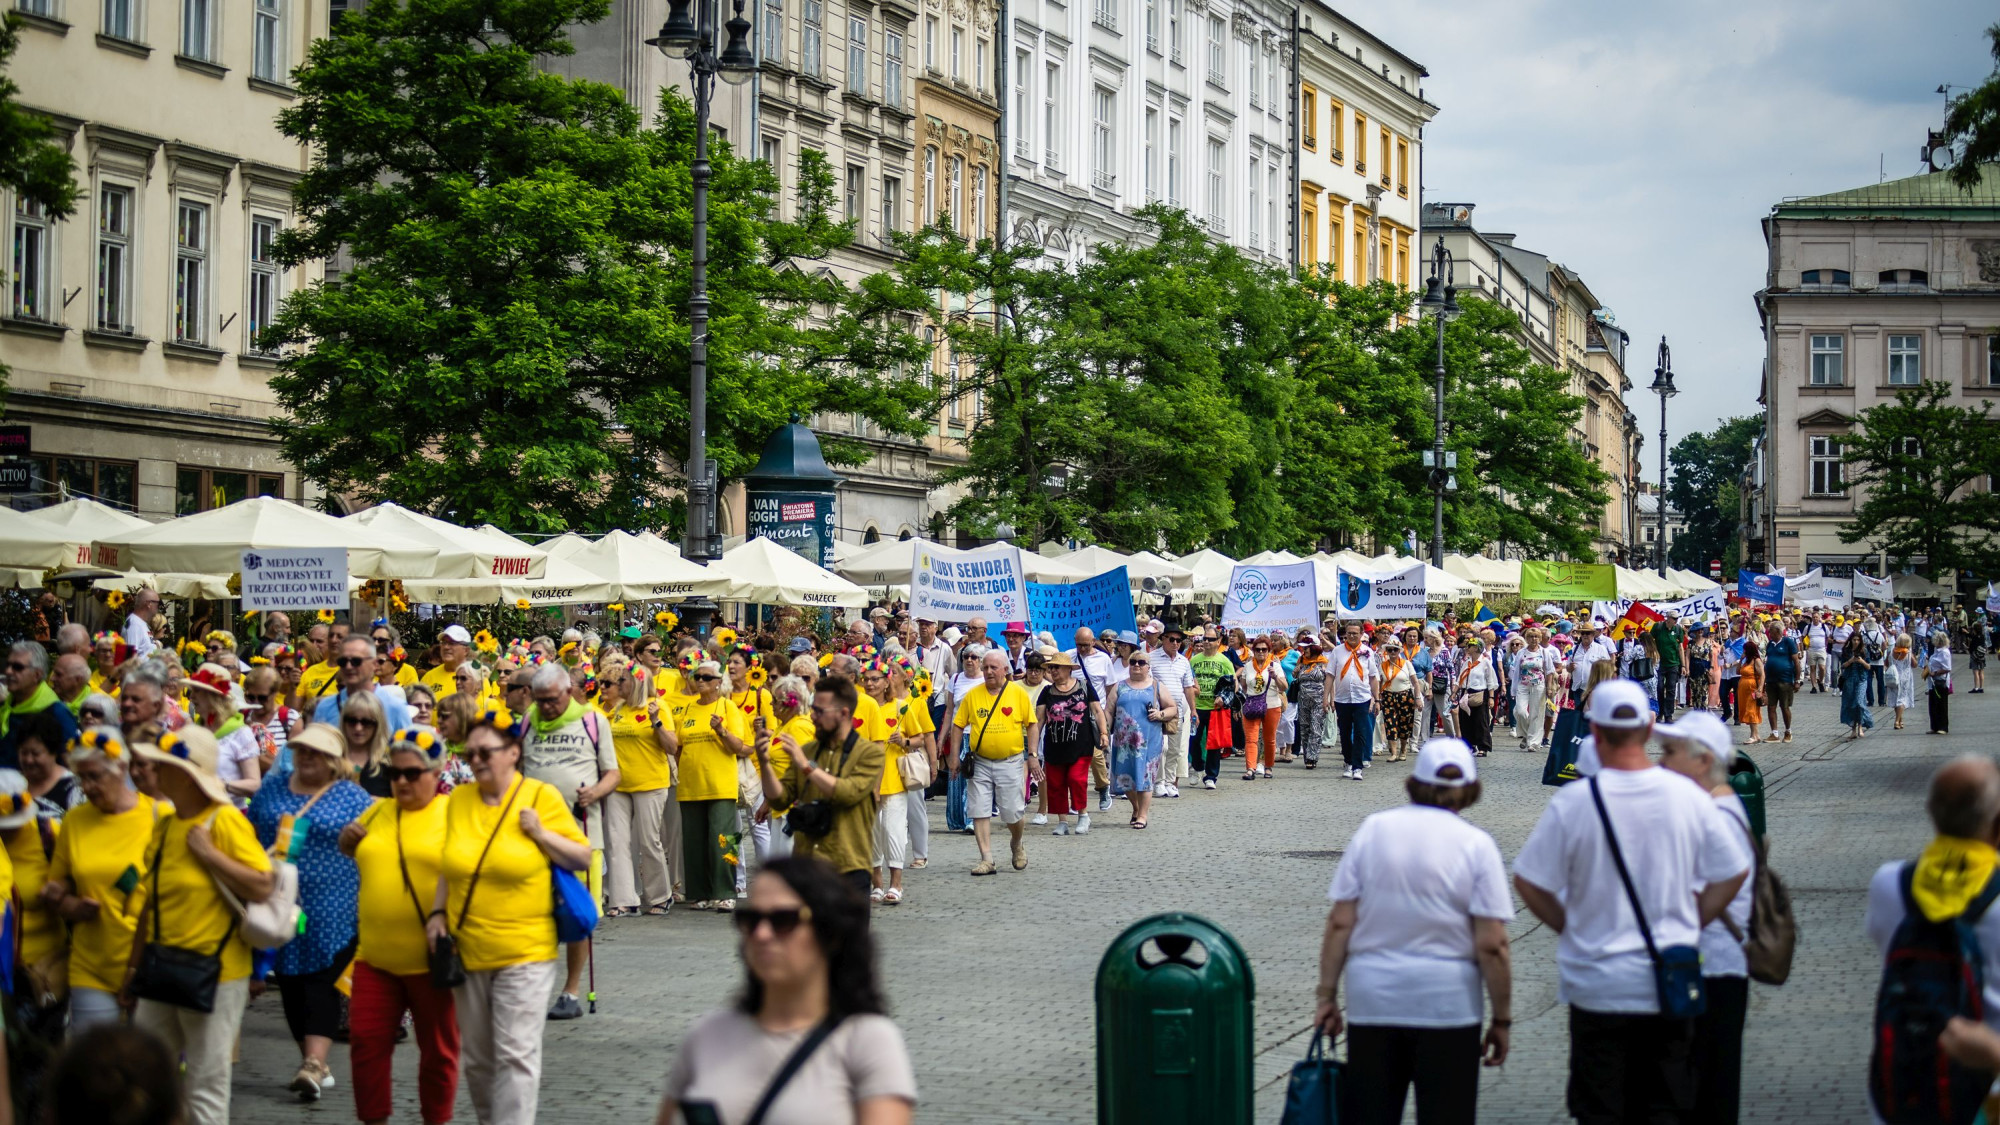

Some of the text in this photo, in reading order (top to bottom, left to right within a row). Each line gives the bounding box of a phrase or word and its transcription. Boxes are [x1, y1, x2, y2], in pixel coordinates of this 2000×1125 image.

[754, 499, 778, 511] VAN
[749, 512, 778, 523] GOGH
[755, 523, 812, 539] Vincent
[266, 558, 324, 568] MEDYCZNY
[492, 556, 531, 575] ŻYWIEC
[957, 558, 1012, 578] SENIORA
[258, 570, 332, 580] UNIWERSYTET
[248, 583, 344, 593] TRZECIEGO WIEKU
[652, 584, 694, 595] KSIĄŻĘCE
[957, 574, 1016, 595] DZIERZGOŃ
[1026, 577, 1111, 597] NIWERSYTET
[1234, 579, 1305, 591] pacjent wybiera
[531, 586, 573, 600] KSIĄŻĘCE
[1376, 585, 1426, 596] Seniorów
[252, 597, 269, 605] WE
[803, 592, 837, 603] KSIĄŻĘCE
[1427, 593, 1448, 601] OKOCIM
[1028, 599, 1081, 609] CIEGO
[532, 734, 586, 746] EMERYT
